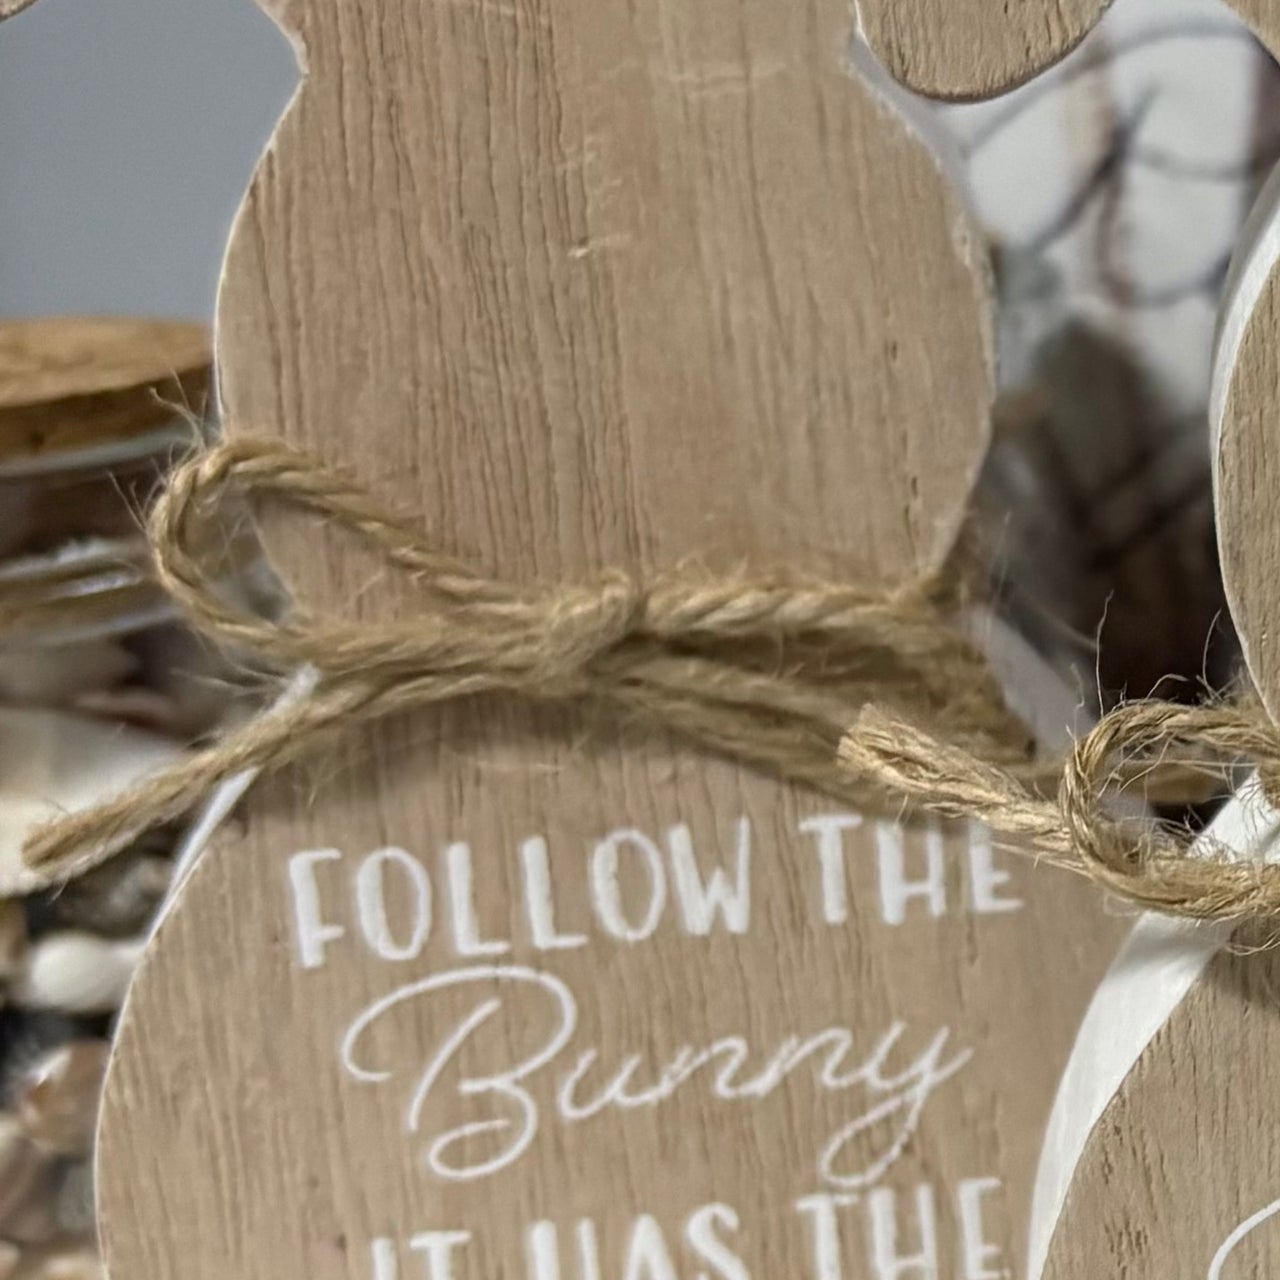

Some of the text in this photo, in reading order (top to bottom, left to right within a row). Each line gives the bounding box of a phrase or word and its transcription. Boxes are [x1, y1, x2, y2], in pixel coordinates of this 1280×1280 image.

[288, 813, 1024, 968] FOLLOW THE
[341, 965, 974, 1187] Bunny
